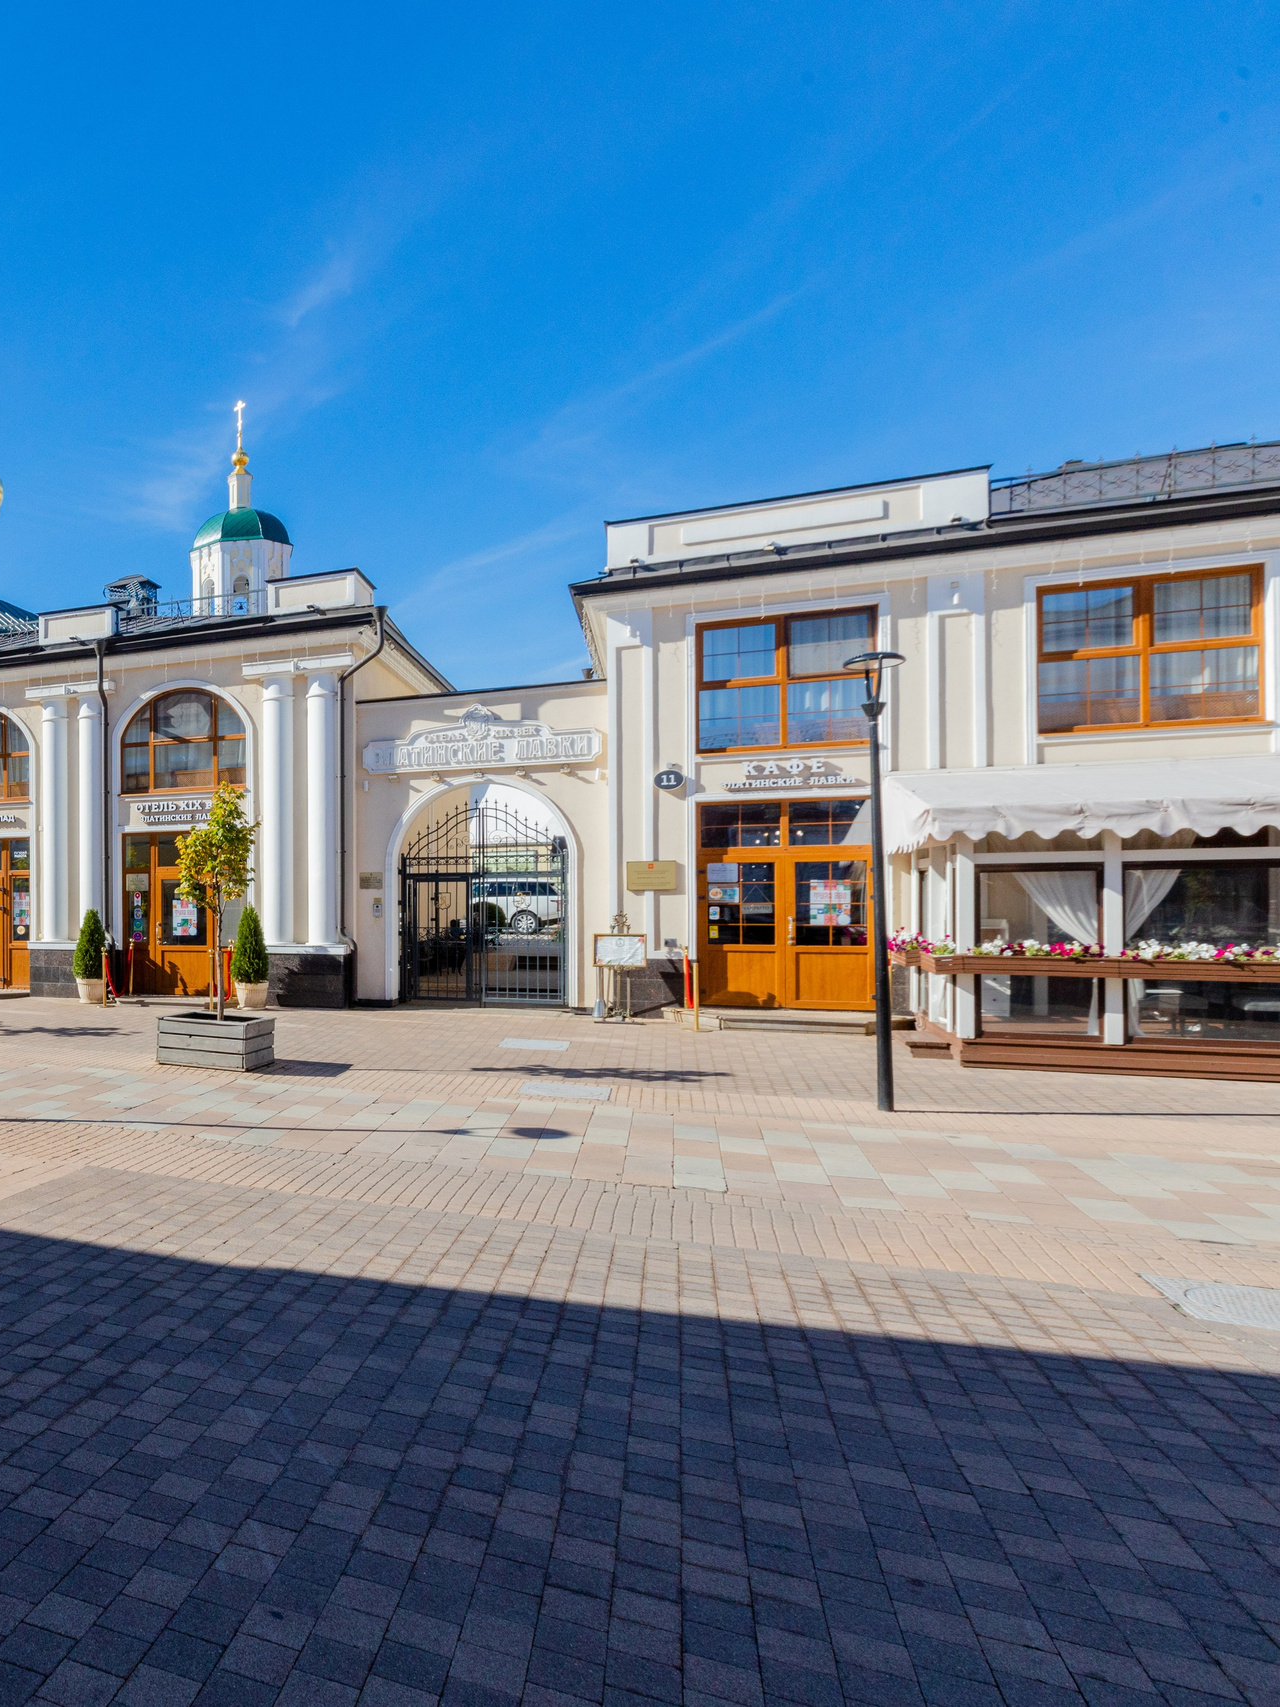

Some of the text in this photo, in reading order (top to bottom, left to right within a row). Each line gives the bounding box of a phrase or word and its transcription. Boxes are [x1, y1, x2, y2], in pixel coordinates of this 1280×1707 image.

[424, 726, 537, 743] ОТЕЛЬ XIX ВЕК
[515, 734, 589, 760] ЛАВКИ
[742, 757, 826, 776] КАФЕ
[661, 774, 677, 786] 11
[721, 775, 856, 790] ЗЛАТИНСКИЕ ЛАВКИ
[135, 801, 177, 813] ОТЕЛЬ
[179, 799, 202, 811] XIX
[140, 812, 212, 823] ЗЛАТИНСКИЕ ЛАВ
